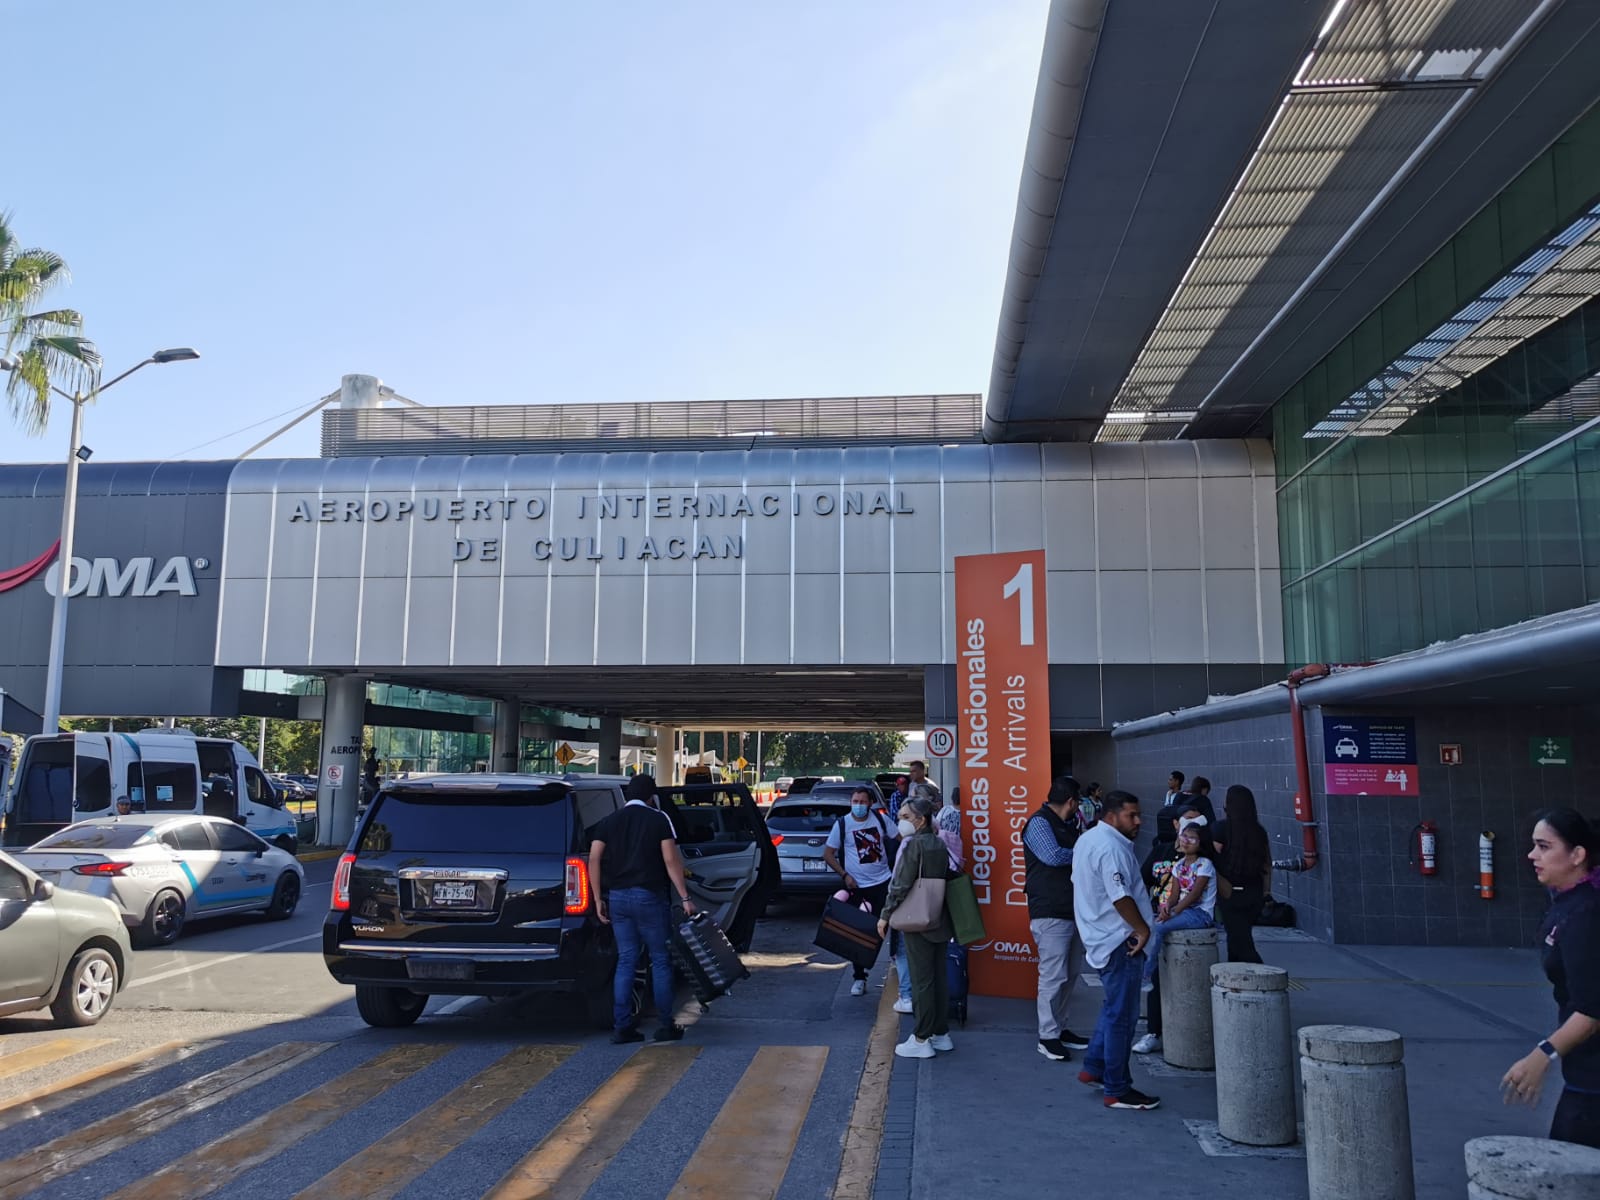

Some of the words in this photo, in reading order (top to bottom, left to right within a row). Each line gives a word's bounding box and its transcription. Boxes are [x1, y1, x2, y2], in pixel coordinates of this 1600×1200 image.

[288, 497, 547, 522] AEROPUERTO
[577, 490, 915, 519] INTERNACIONAL
[452, 538, 499, 562] DE
[535, 535, 743, 561] CULIACAN
[1003, 563, 1034, 646] 1
[962, 617, 988, 768] Nacionales
[934, 733, 947, 746] 10
[1001, 674, 1027, 772] Arrivals
[966, 777, 996, 905] Llegadas
[1003, 785, 1029, 906] Domestic
[352, 924, 385, 933] YUKON
[993, 941, 1031, 955] OMA
